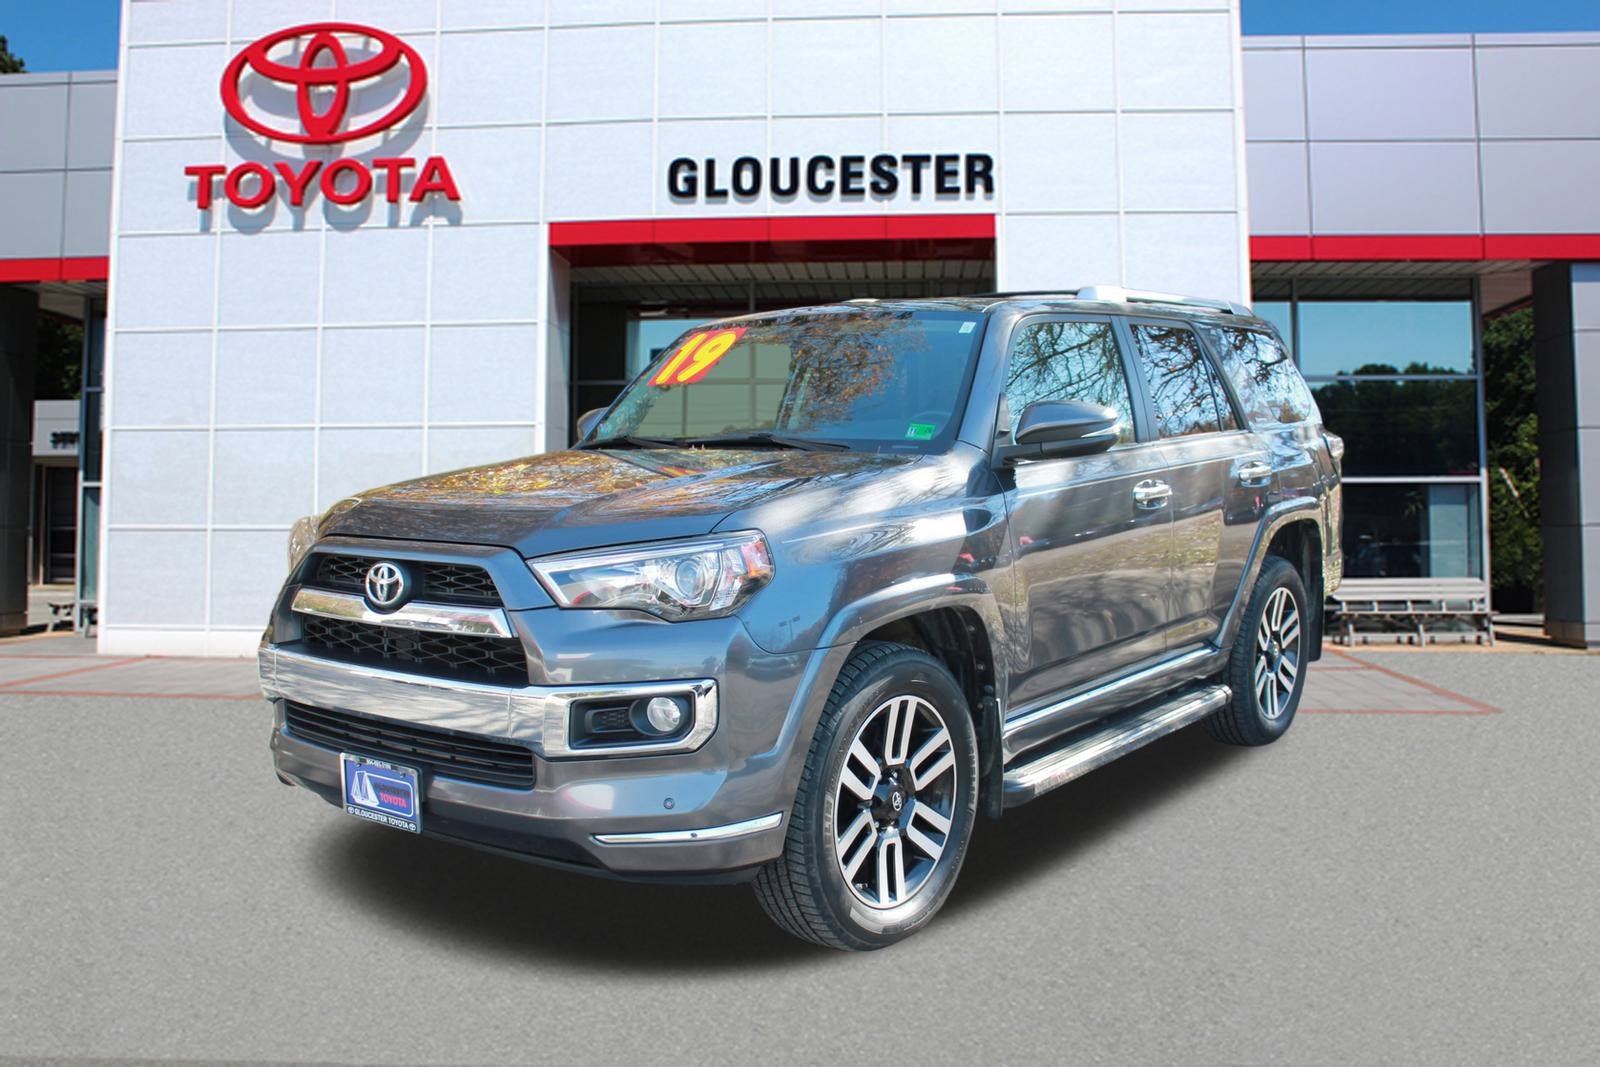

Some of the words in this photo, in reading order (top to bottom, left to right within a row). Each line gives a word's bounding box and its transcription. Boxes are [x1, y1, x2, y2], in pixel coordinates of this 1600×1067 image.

[184, 156, 461, 210] TOYOTA
[668, 153, 995, 198] GLOUCESTER
[655, 331, 737, 385] 19
[354, 808, 388, 823] GLOUCESTER
[388, 817, 409, 829] TOYOTA
[380, 792, 407, 808] TOYOTA
